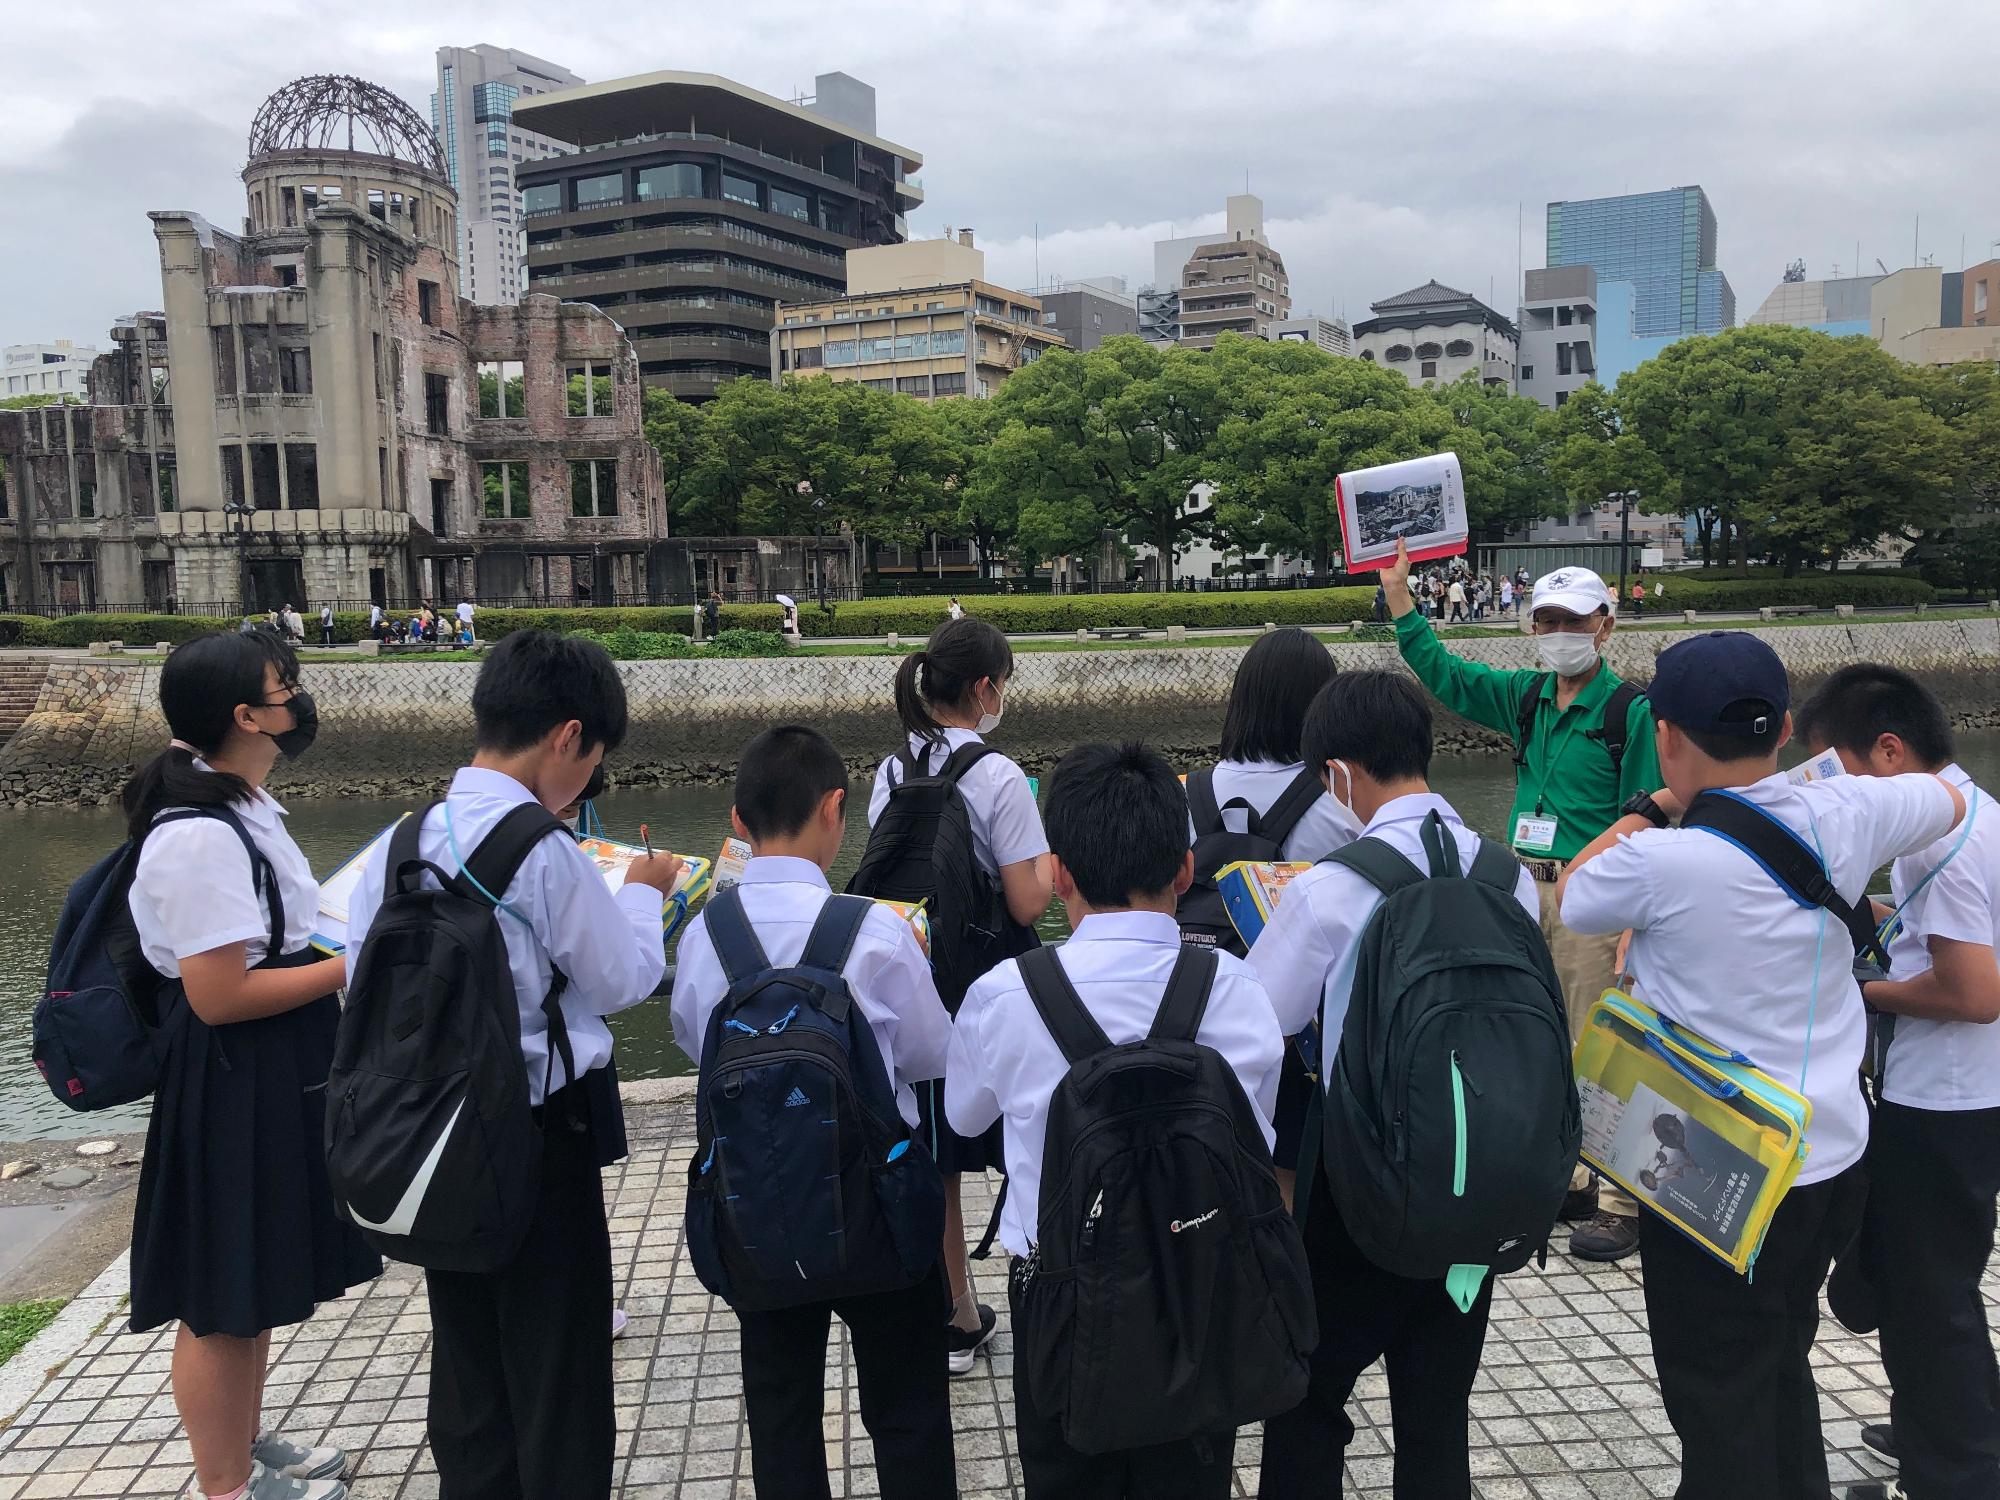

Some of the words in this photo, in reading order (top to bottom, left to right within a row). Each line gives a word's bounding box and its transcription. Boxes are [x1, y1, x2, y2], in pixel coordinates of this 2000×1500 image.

[785, 1097, 811, 1107] adidas
[1718, 1171, 1749, 1235] 広島平和記念資料館
[1170, 1208, 1219, 1233] Champion
